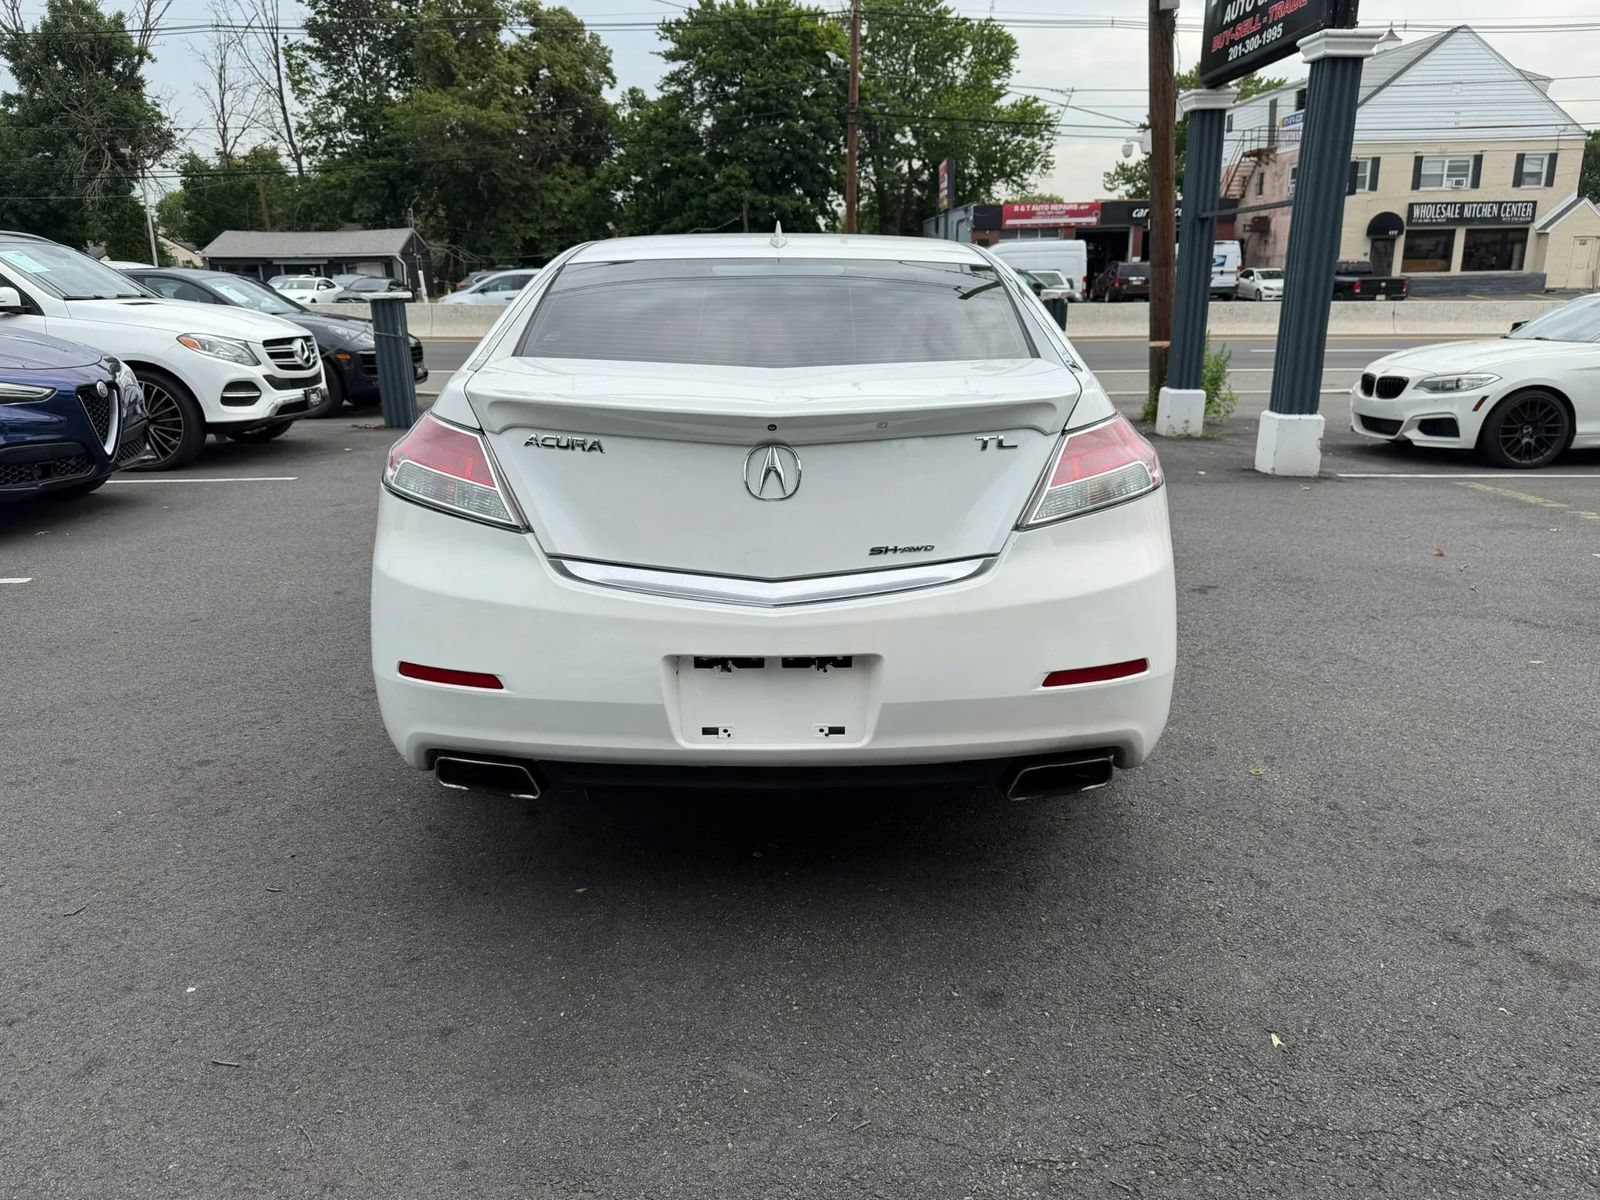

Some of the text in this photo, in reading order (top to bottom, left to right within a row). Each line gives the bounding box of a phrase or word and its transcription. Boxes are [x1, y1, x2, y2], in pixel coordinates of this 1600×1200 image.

[1223, 0, 1253, 25] AUTO
[1228, 22, 1284, 61] 201-300-1995
[1413, 202, 1534, 219] WHOLESALE KITCHEN CENTER
[523, 433, 606, 454] ACURA
[975, 435, 1018, 451] TL
[868, 544, 935, 556] SH-AWD
